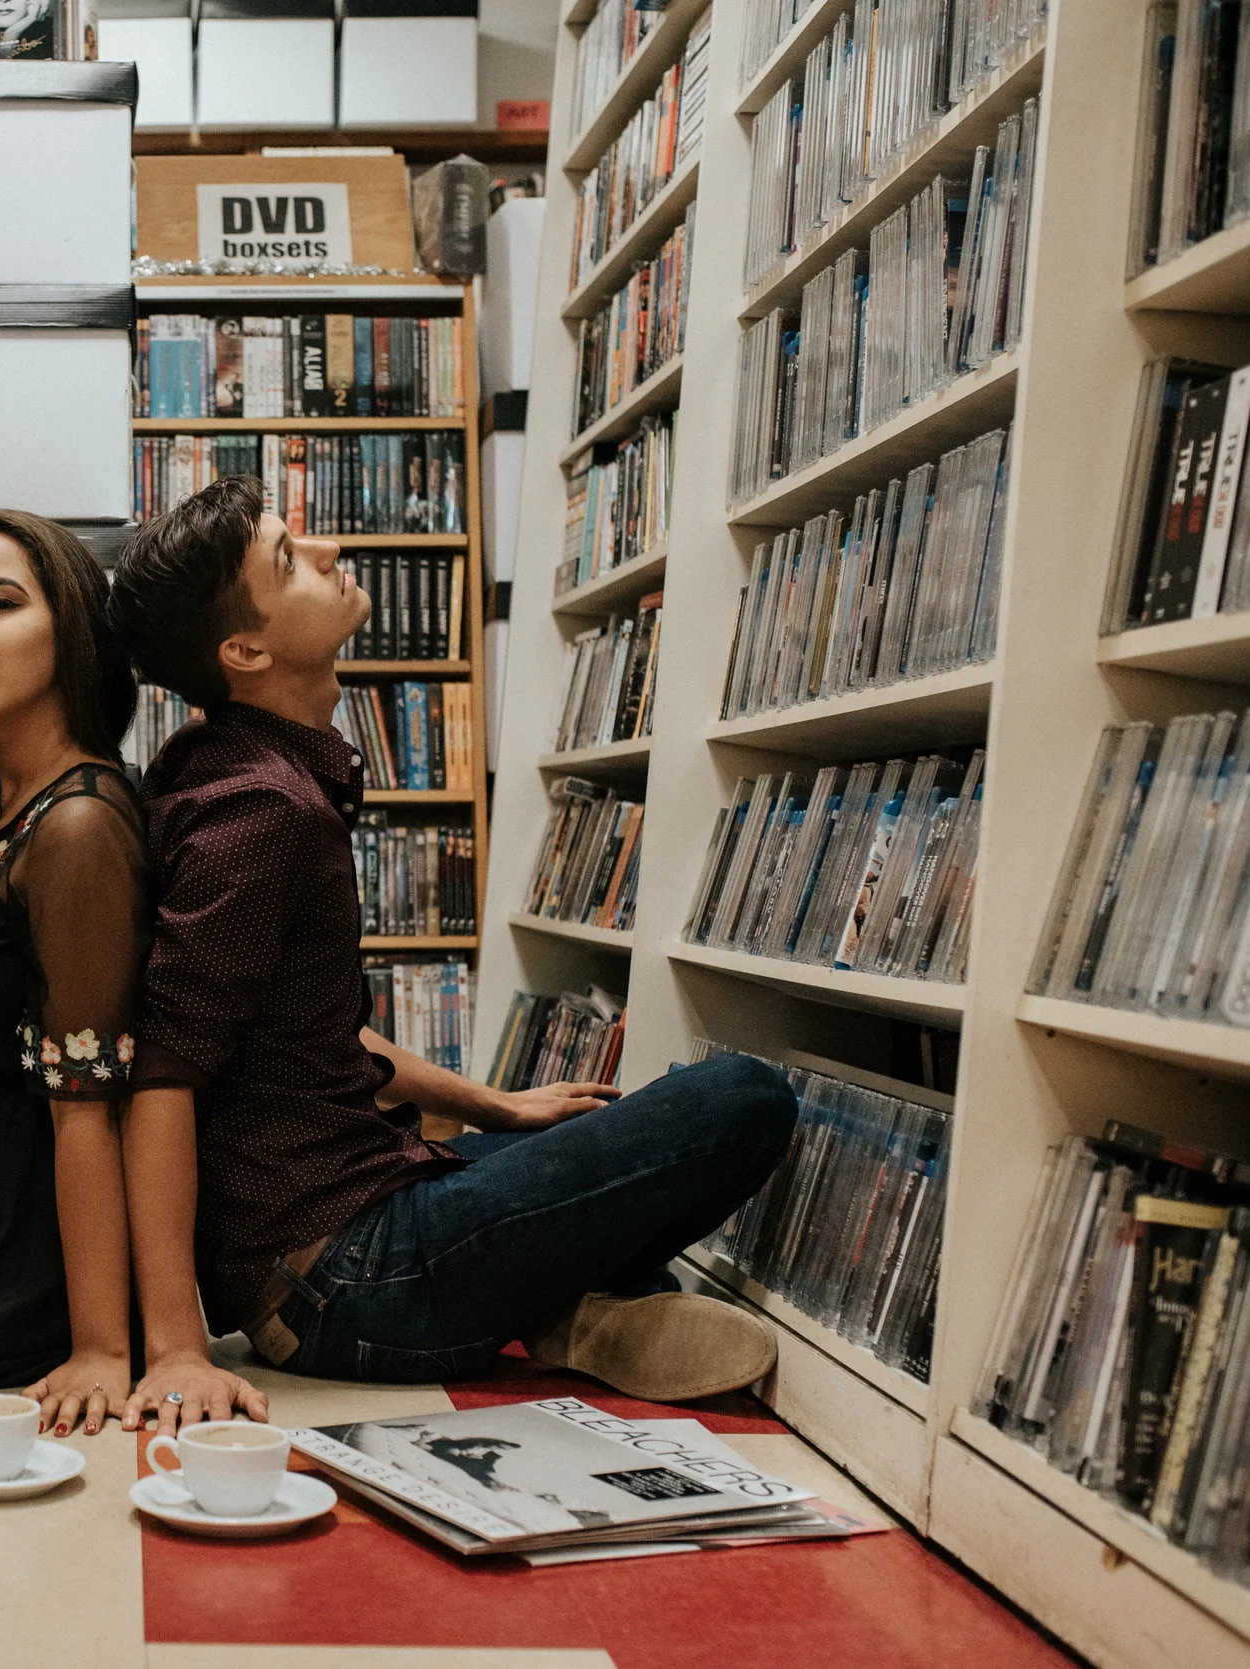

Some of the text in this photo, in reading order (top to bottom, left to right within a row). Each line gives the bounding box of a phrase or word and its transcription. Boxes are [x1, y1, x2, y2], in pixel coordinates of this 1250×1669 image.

[222, 196, 326, 235] DVD
[223, 240, 327, 258] boxsets
[1171, 440, 1195, 505] TRUE
[1193, 431, 1217, 498] TRUE
[288, 1431, 402, 1482] STRANGE
[535, 1400, 794, 1497] BLEACHERS
